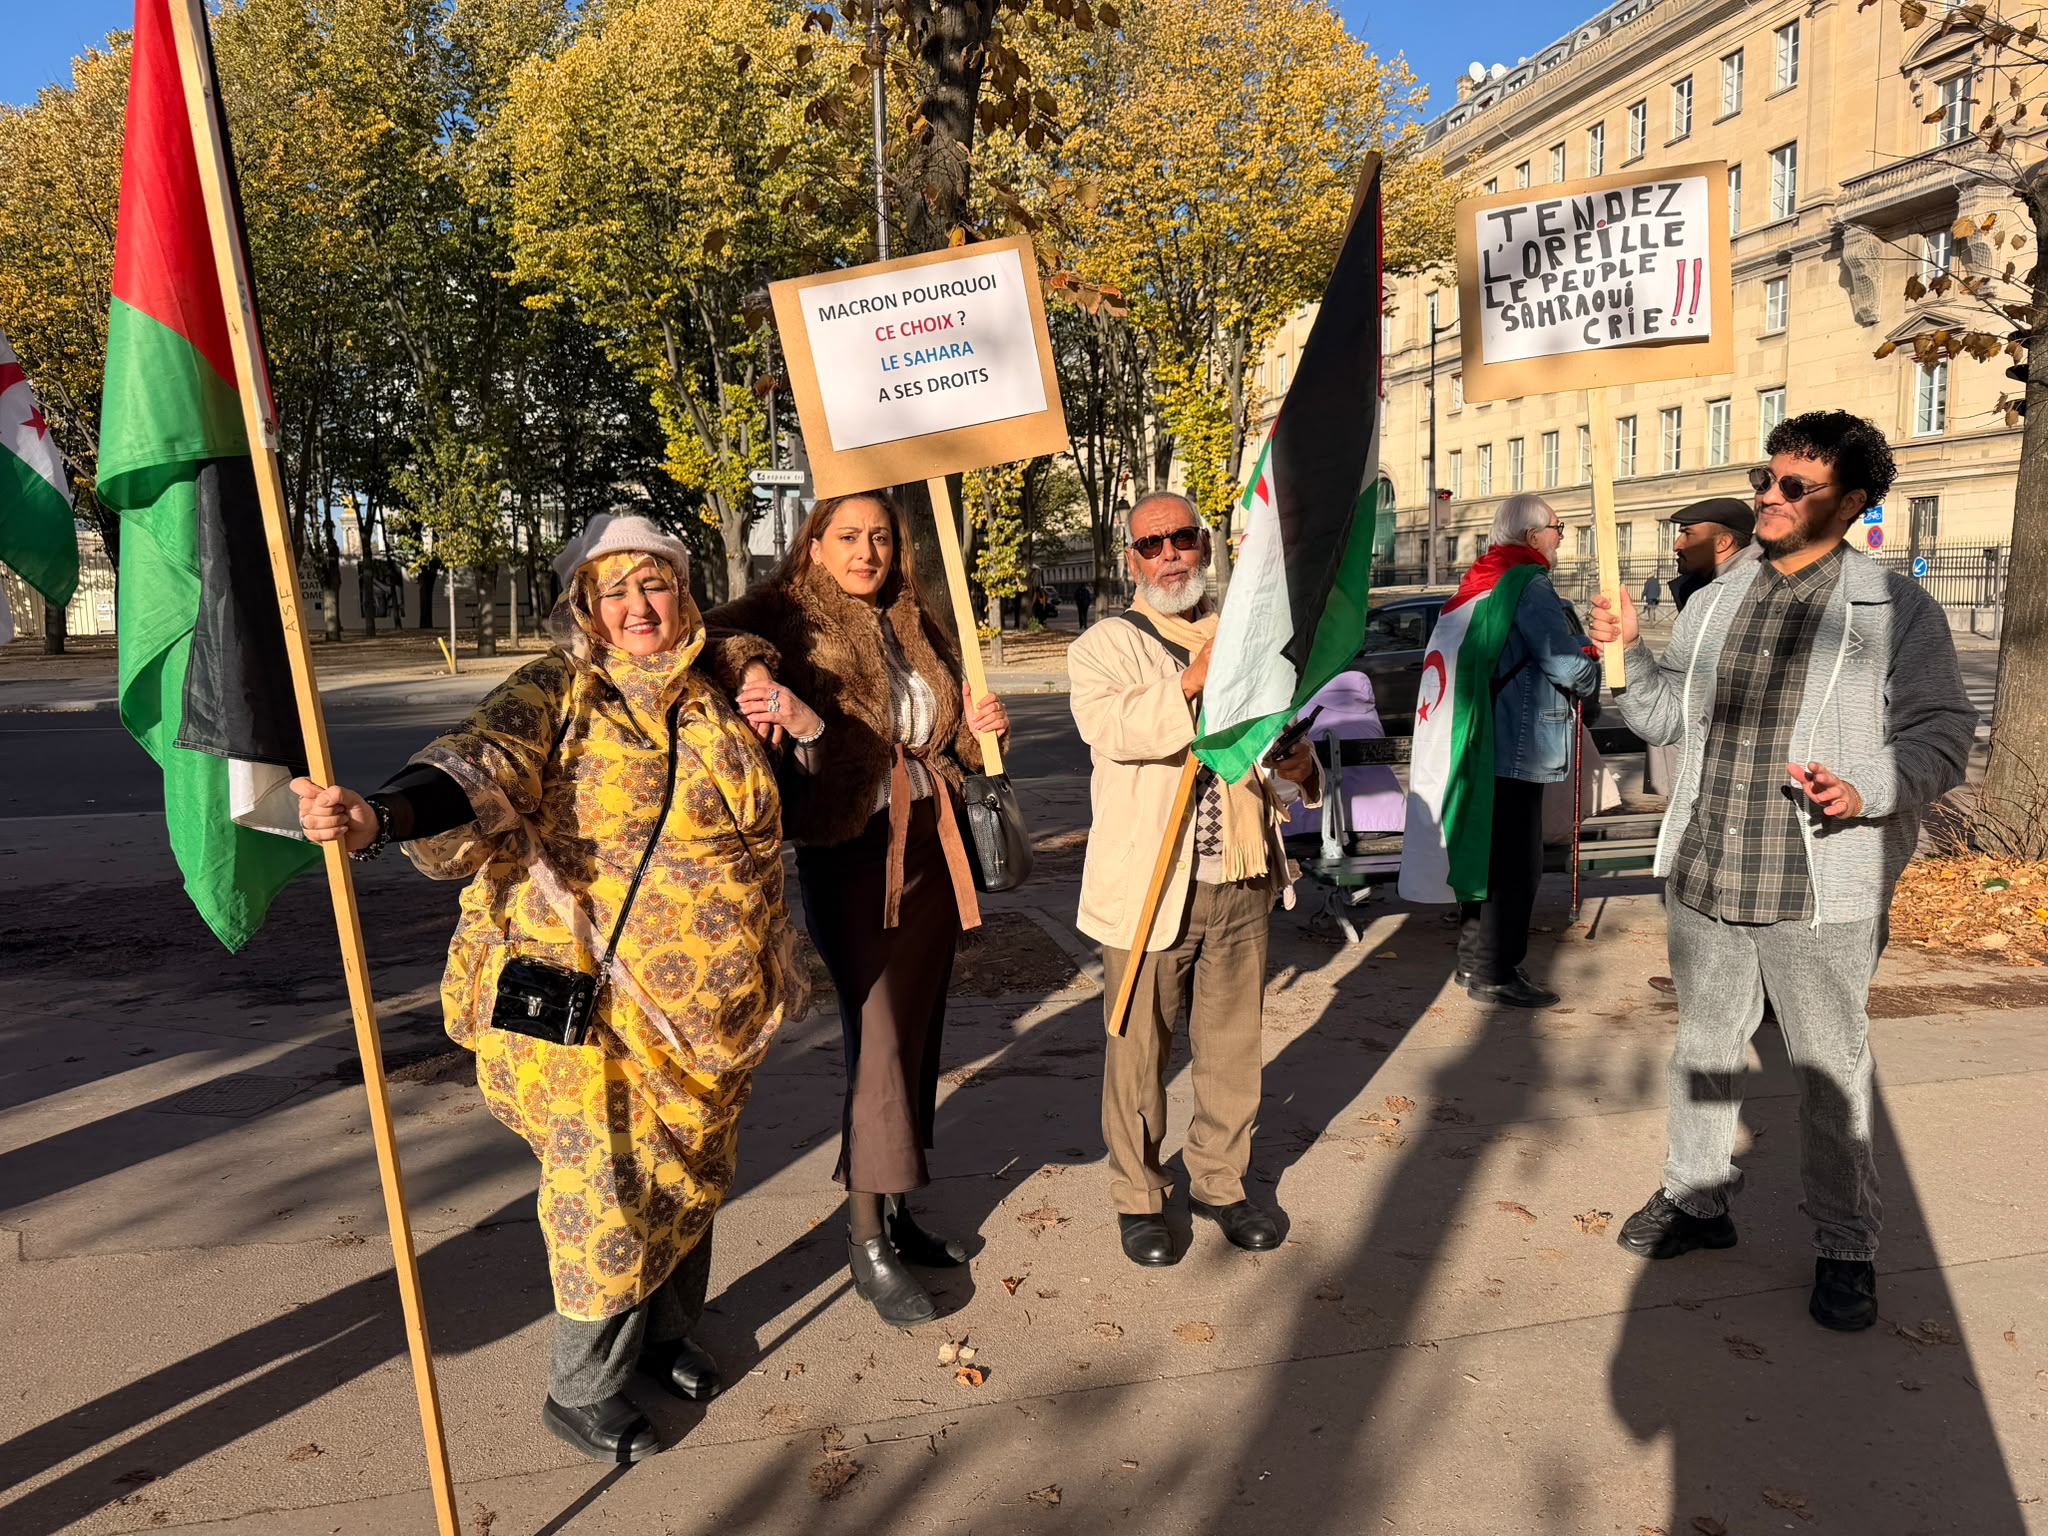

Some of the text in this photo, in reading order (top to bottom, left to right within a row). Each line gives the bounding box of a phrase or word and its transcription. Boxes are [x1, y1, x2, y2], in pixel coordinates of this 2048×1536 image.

[1487, 182, 1682, 242] TENDEZ
[818, 274, 997, 322] MACRON POURQUOI
[1484, 252, 1657, 309] LE PEUPLE
[875, 325, 896, 342] CE
[900, 313, 954, 337] CHOIX
[881, 341, 974, 372] LE SAHARA
[878, 367, 989, 402] A SES DROITS
